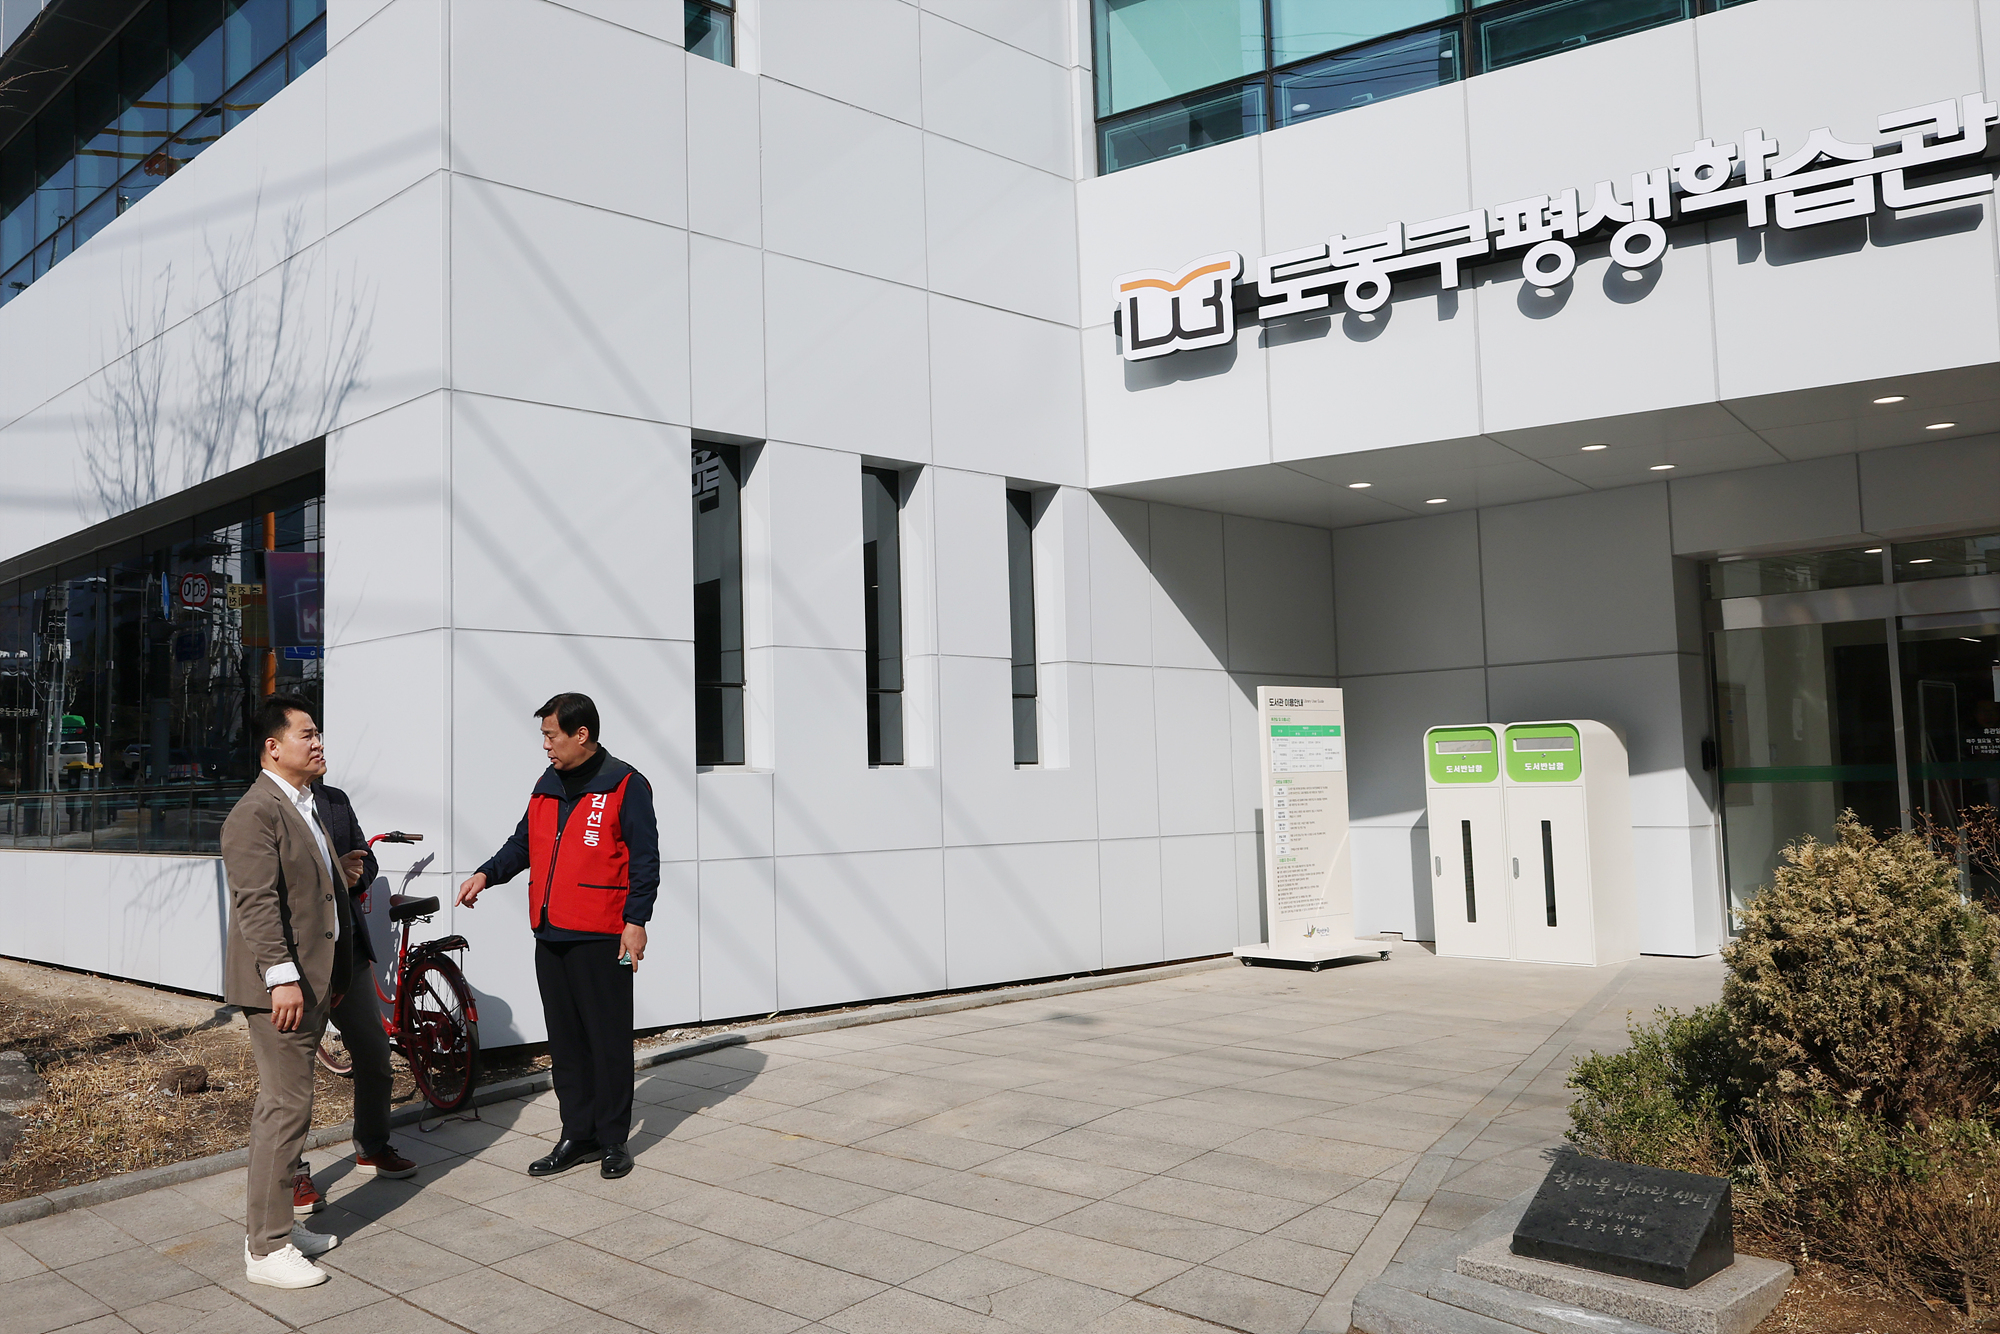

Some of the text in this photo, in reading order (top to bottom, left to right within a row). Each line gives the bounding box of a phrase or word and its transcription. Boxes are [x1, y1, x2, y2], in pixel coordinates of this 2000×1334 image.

[1256, 92, 2000, 321] 도봉구평생학습관
[1446, 765, 1482, 773] 도서반납함
[1525, 763, 1563, 771] 도서반납함
[583, 793, 608, 847] 김선동
